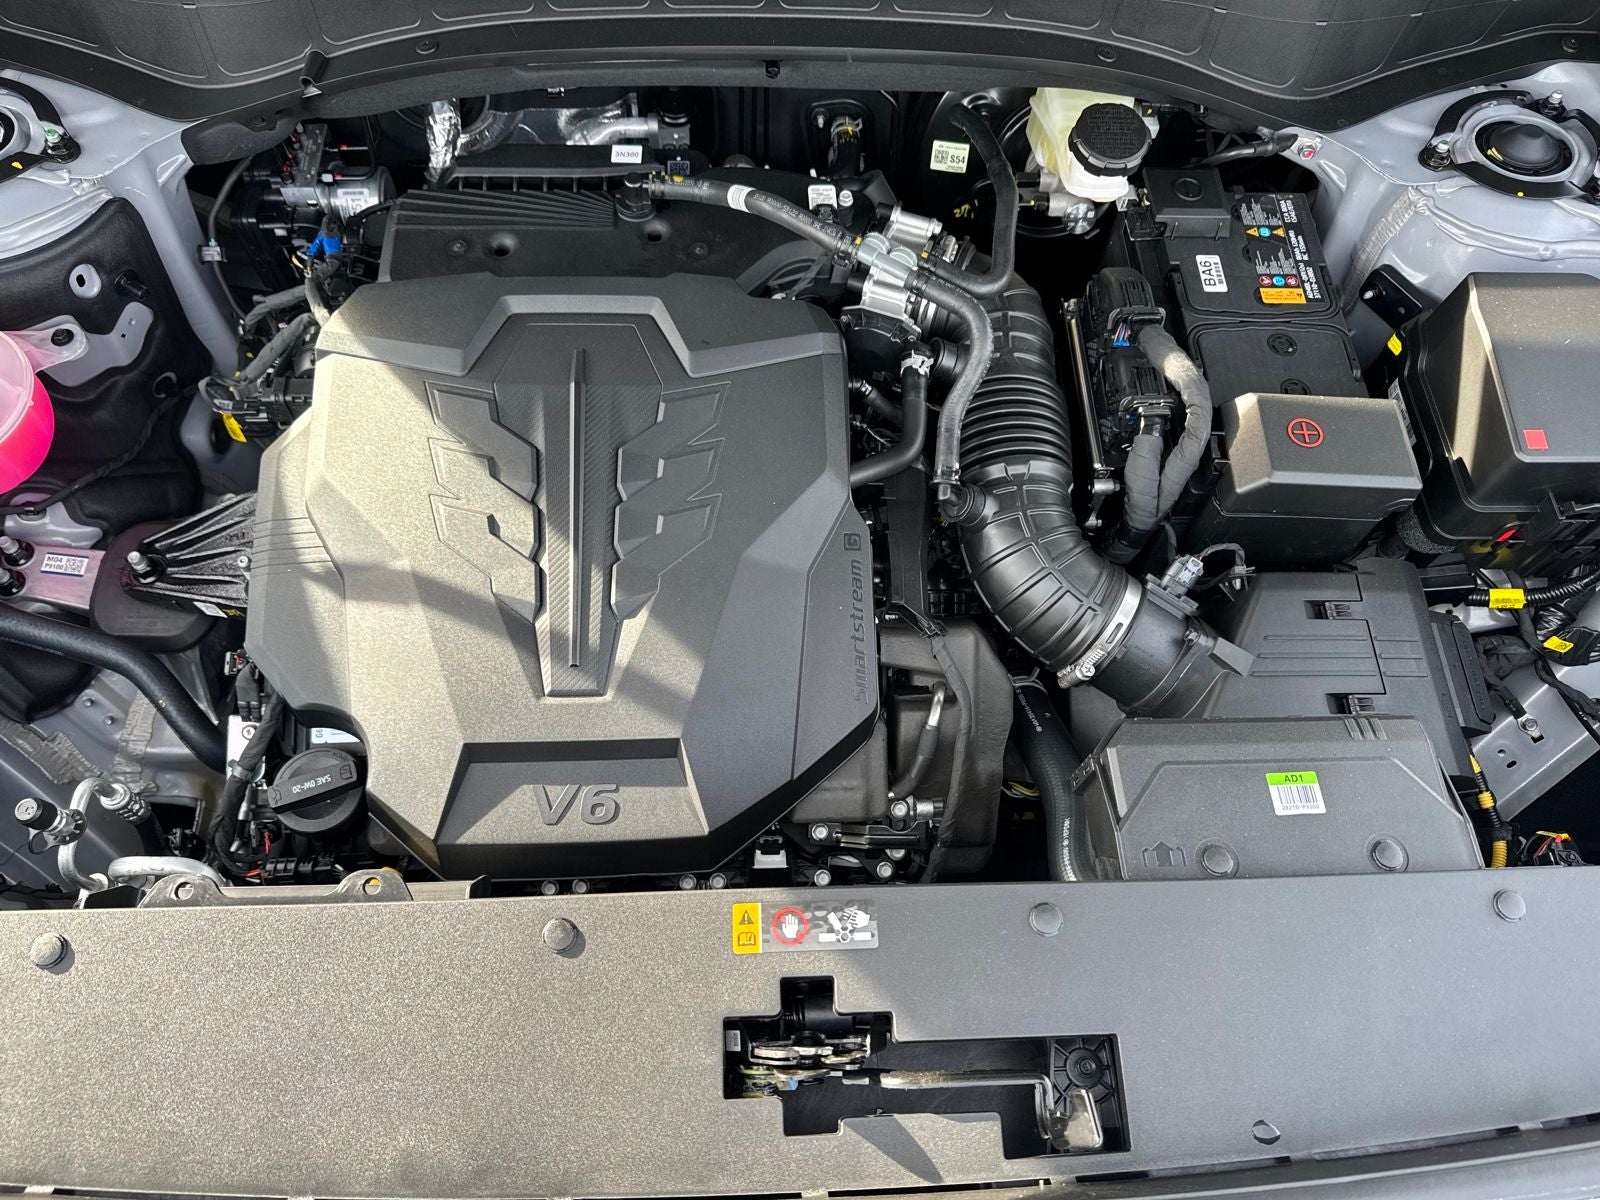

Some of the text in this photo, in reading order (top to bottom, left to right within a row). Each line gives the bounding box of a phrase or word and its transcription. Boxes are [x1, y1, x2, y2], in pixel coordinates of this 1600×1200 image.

[949, 154, 965, 164] S54
[1199, 260, 1216, 286] BA6
[849, 558, 868, 704] Smartstream
[292, 774, 332, 794] SAE 0W-20
[1284, 774, 1304, 783] AD1
[532, 783, 621, 826] V6
